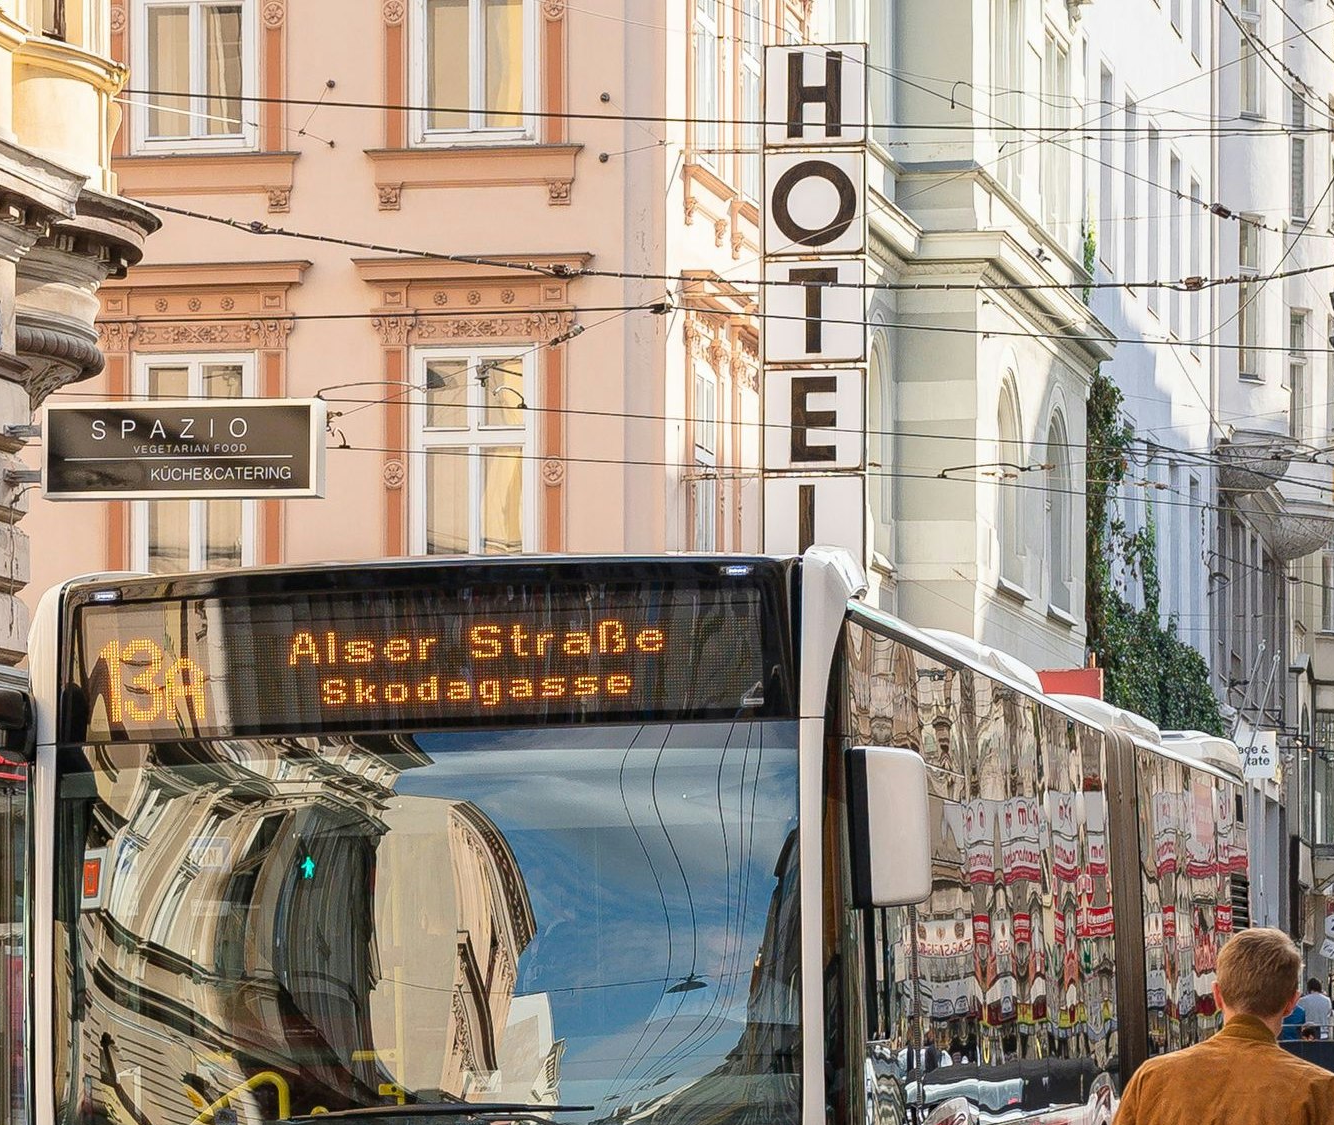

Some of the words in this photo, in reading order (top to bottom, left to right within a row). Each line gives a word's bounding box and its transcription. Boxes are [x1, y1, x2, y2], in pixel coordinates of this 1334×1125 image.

[91, 417, 249, 440] SPAZIO
[133, 445, 210, 454] VEGETARIAN
[214, 443, 248, 453] FOOD
[150, 465, 292, 482] KÜCHE&CATERING
[289, 630, 437, 666] Alser
[470, 619, 667, 660] Straße
[97, 637, 206, 724] 13A
[322, 670, 634, 706] Skodagasse
